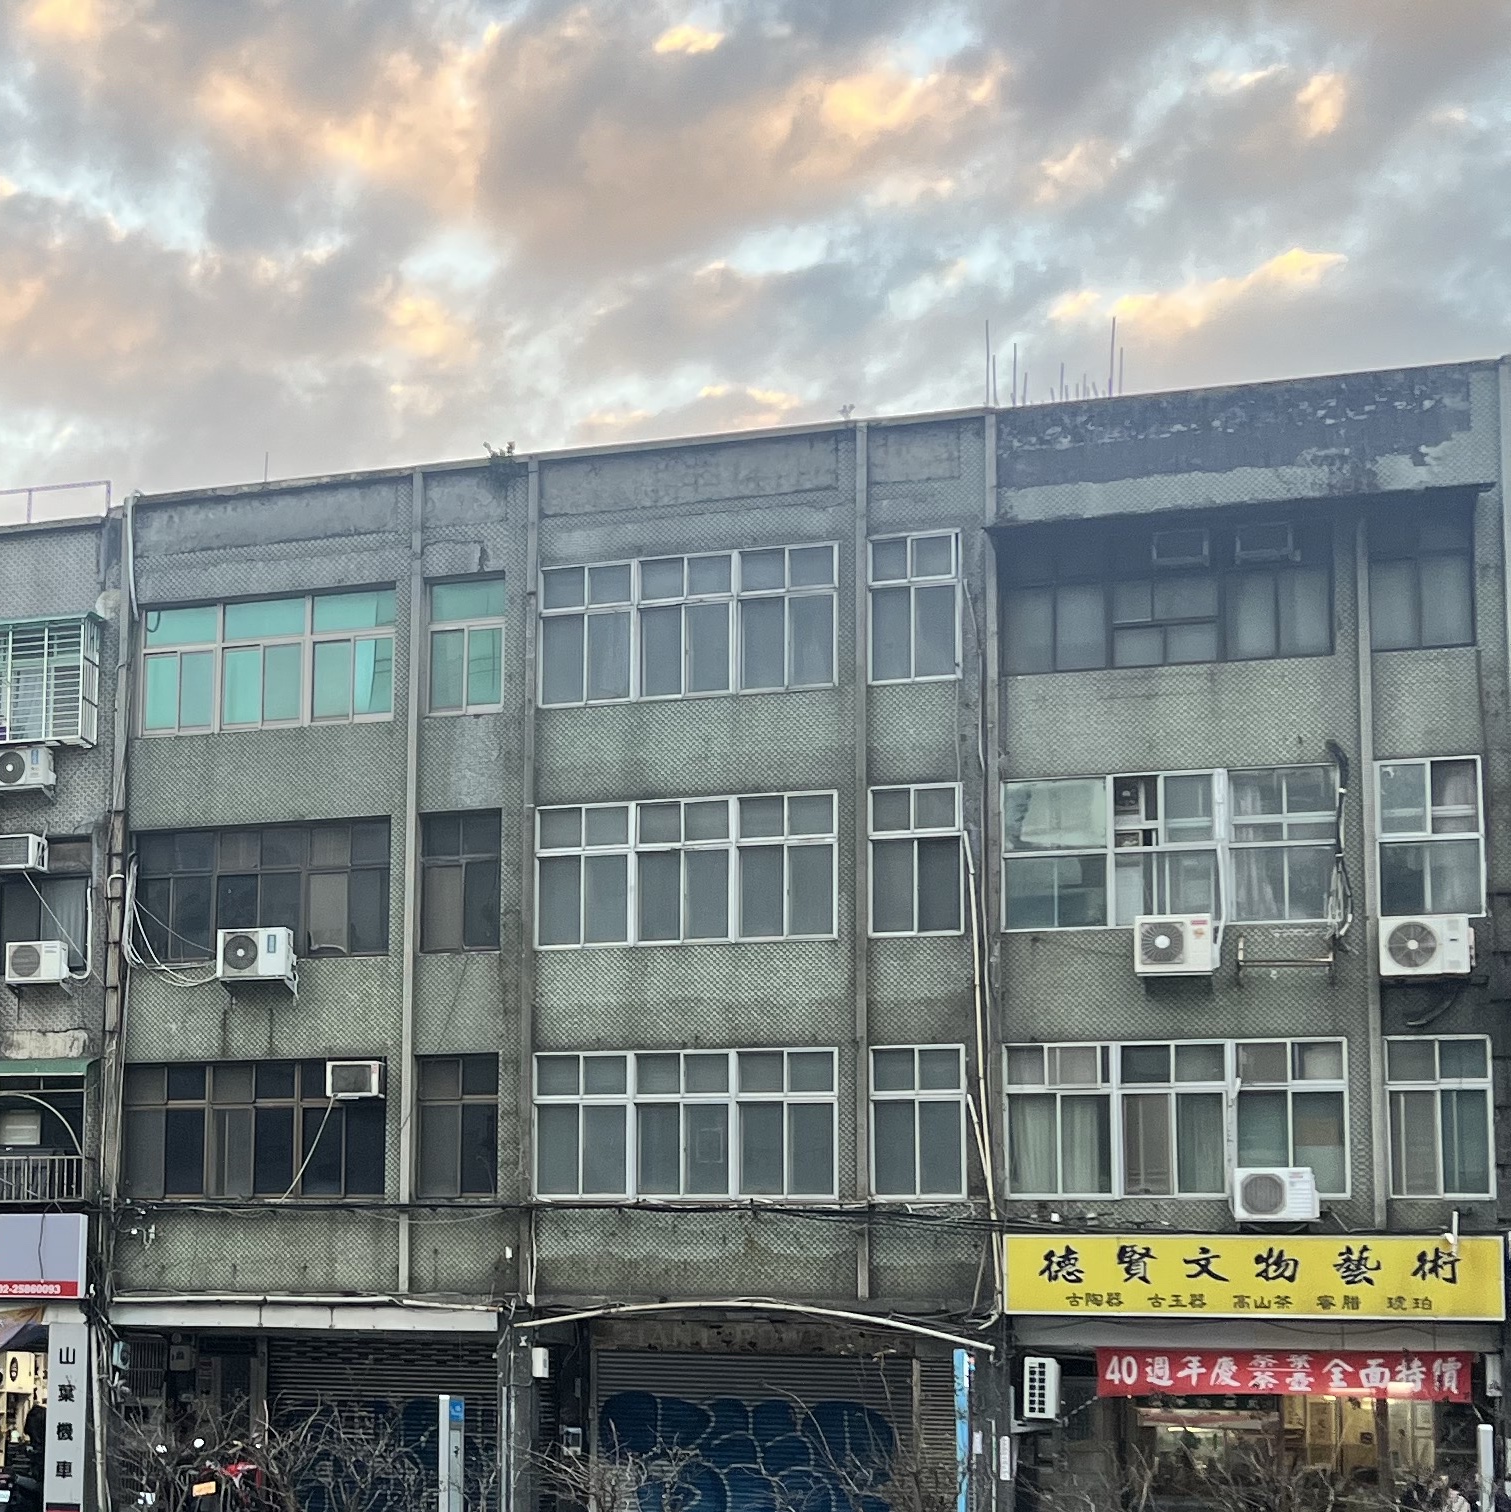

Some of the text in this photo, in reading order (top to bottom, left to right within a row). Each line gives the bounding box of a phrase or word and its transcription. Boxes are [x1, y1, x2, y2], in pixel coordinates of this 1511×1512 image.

[1039, 1245, 1461, 1285] 德賢文物藝術
[1065, 1292, 1124, 1308] 古陶器
[1147, 1293, 1207, 1308] 古玉器
[1232, 1294, 1293, 1310] 高山茶
[1322, 1357, 1462, 1394] 全面特價
[55, 1347, 76, 1478] 山葉機車
